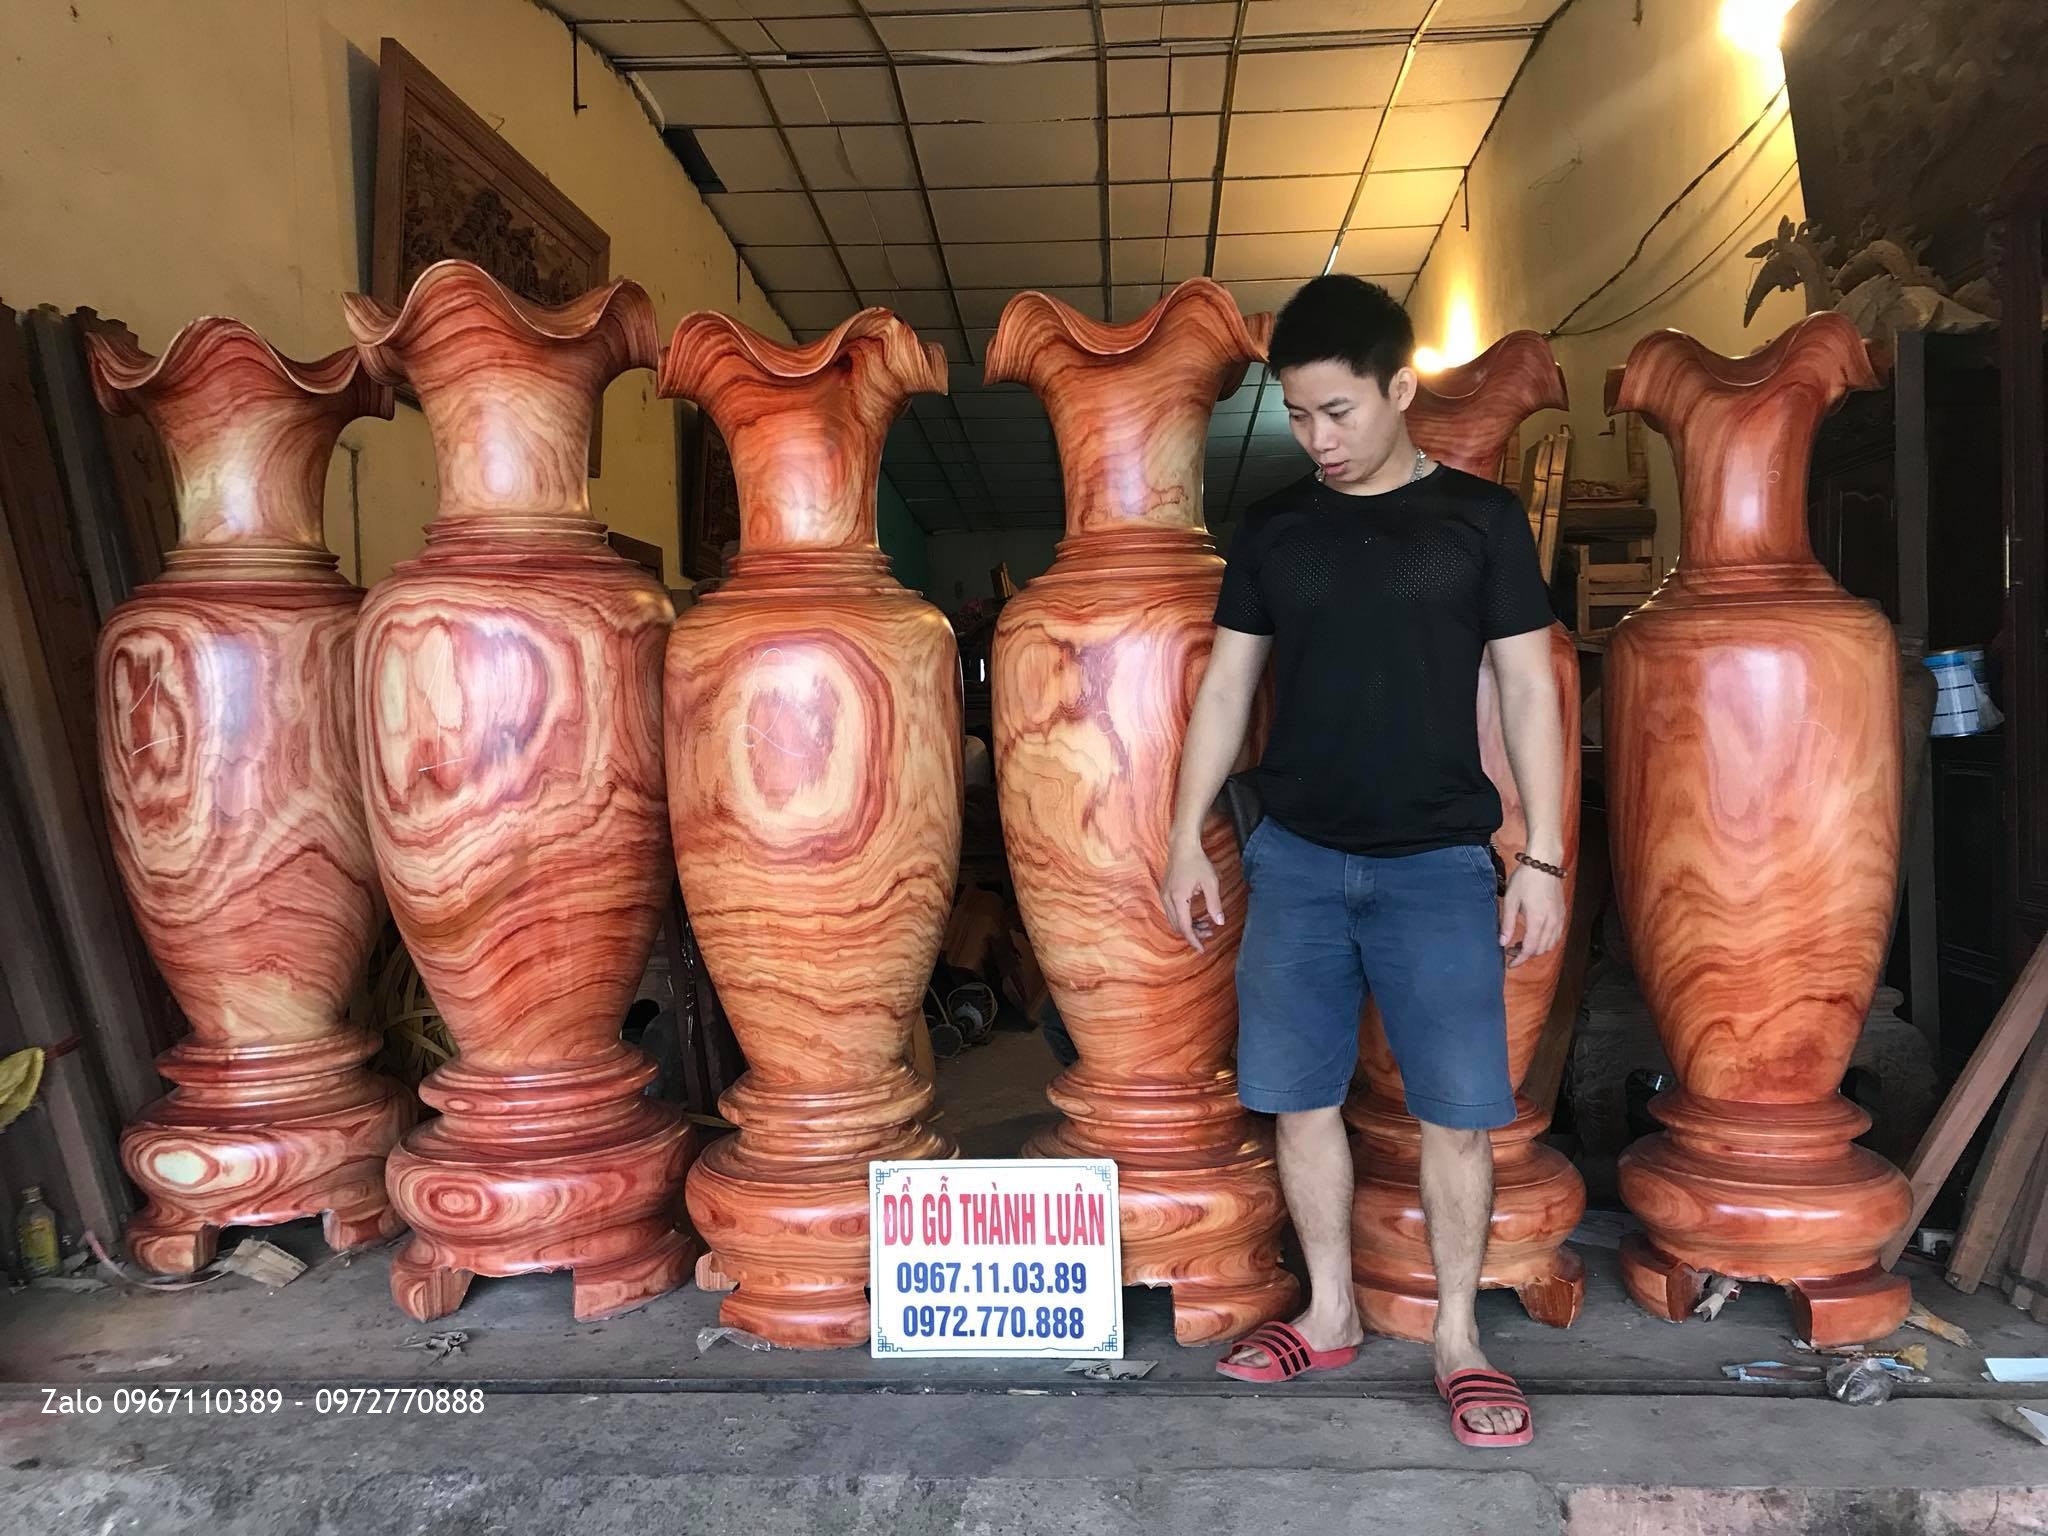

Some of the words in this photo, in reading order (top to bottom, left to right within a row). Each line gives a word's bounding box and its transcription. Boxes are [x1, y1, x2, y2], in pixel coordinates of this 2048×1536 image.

[922, 1175, 953, 1246] GỖ
[959, 1181, 1037, 1246] THÀNH
[1044, 1182, 1106, 1246] LUÂN
[896, 1262, 1088, 1294] 0967.11.03.89
[902, 1305, 1085, 1339] 0972.770.888
